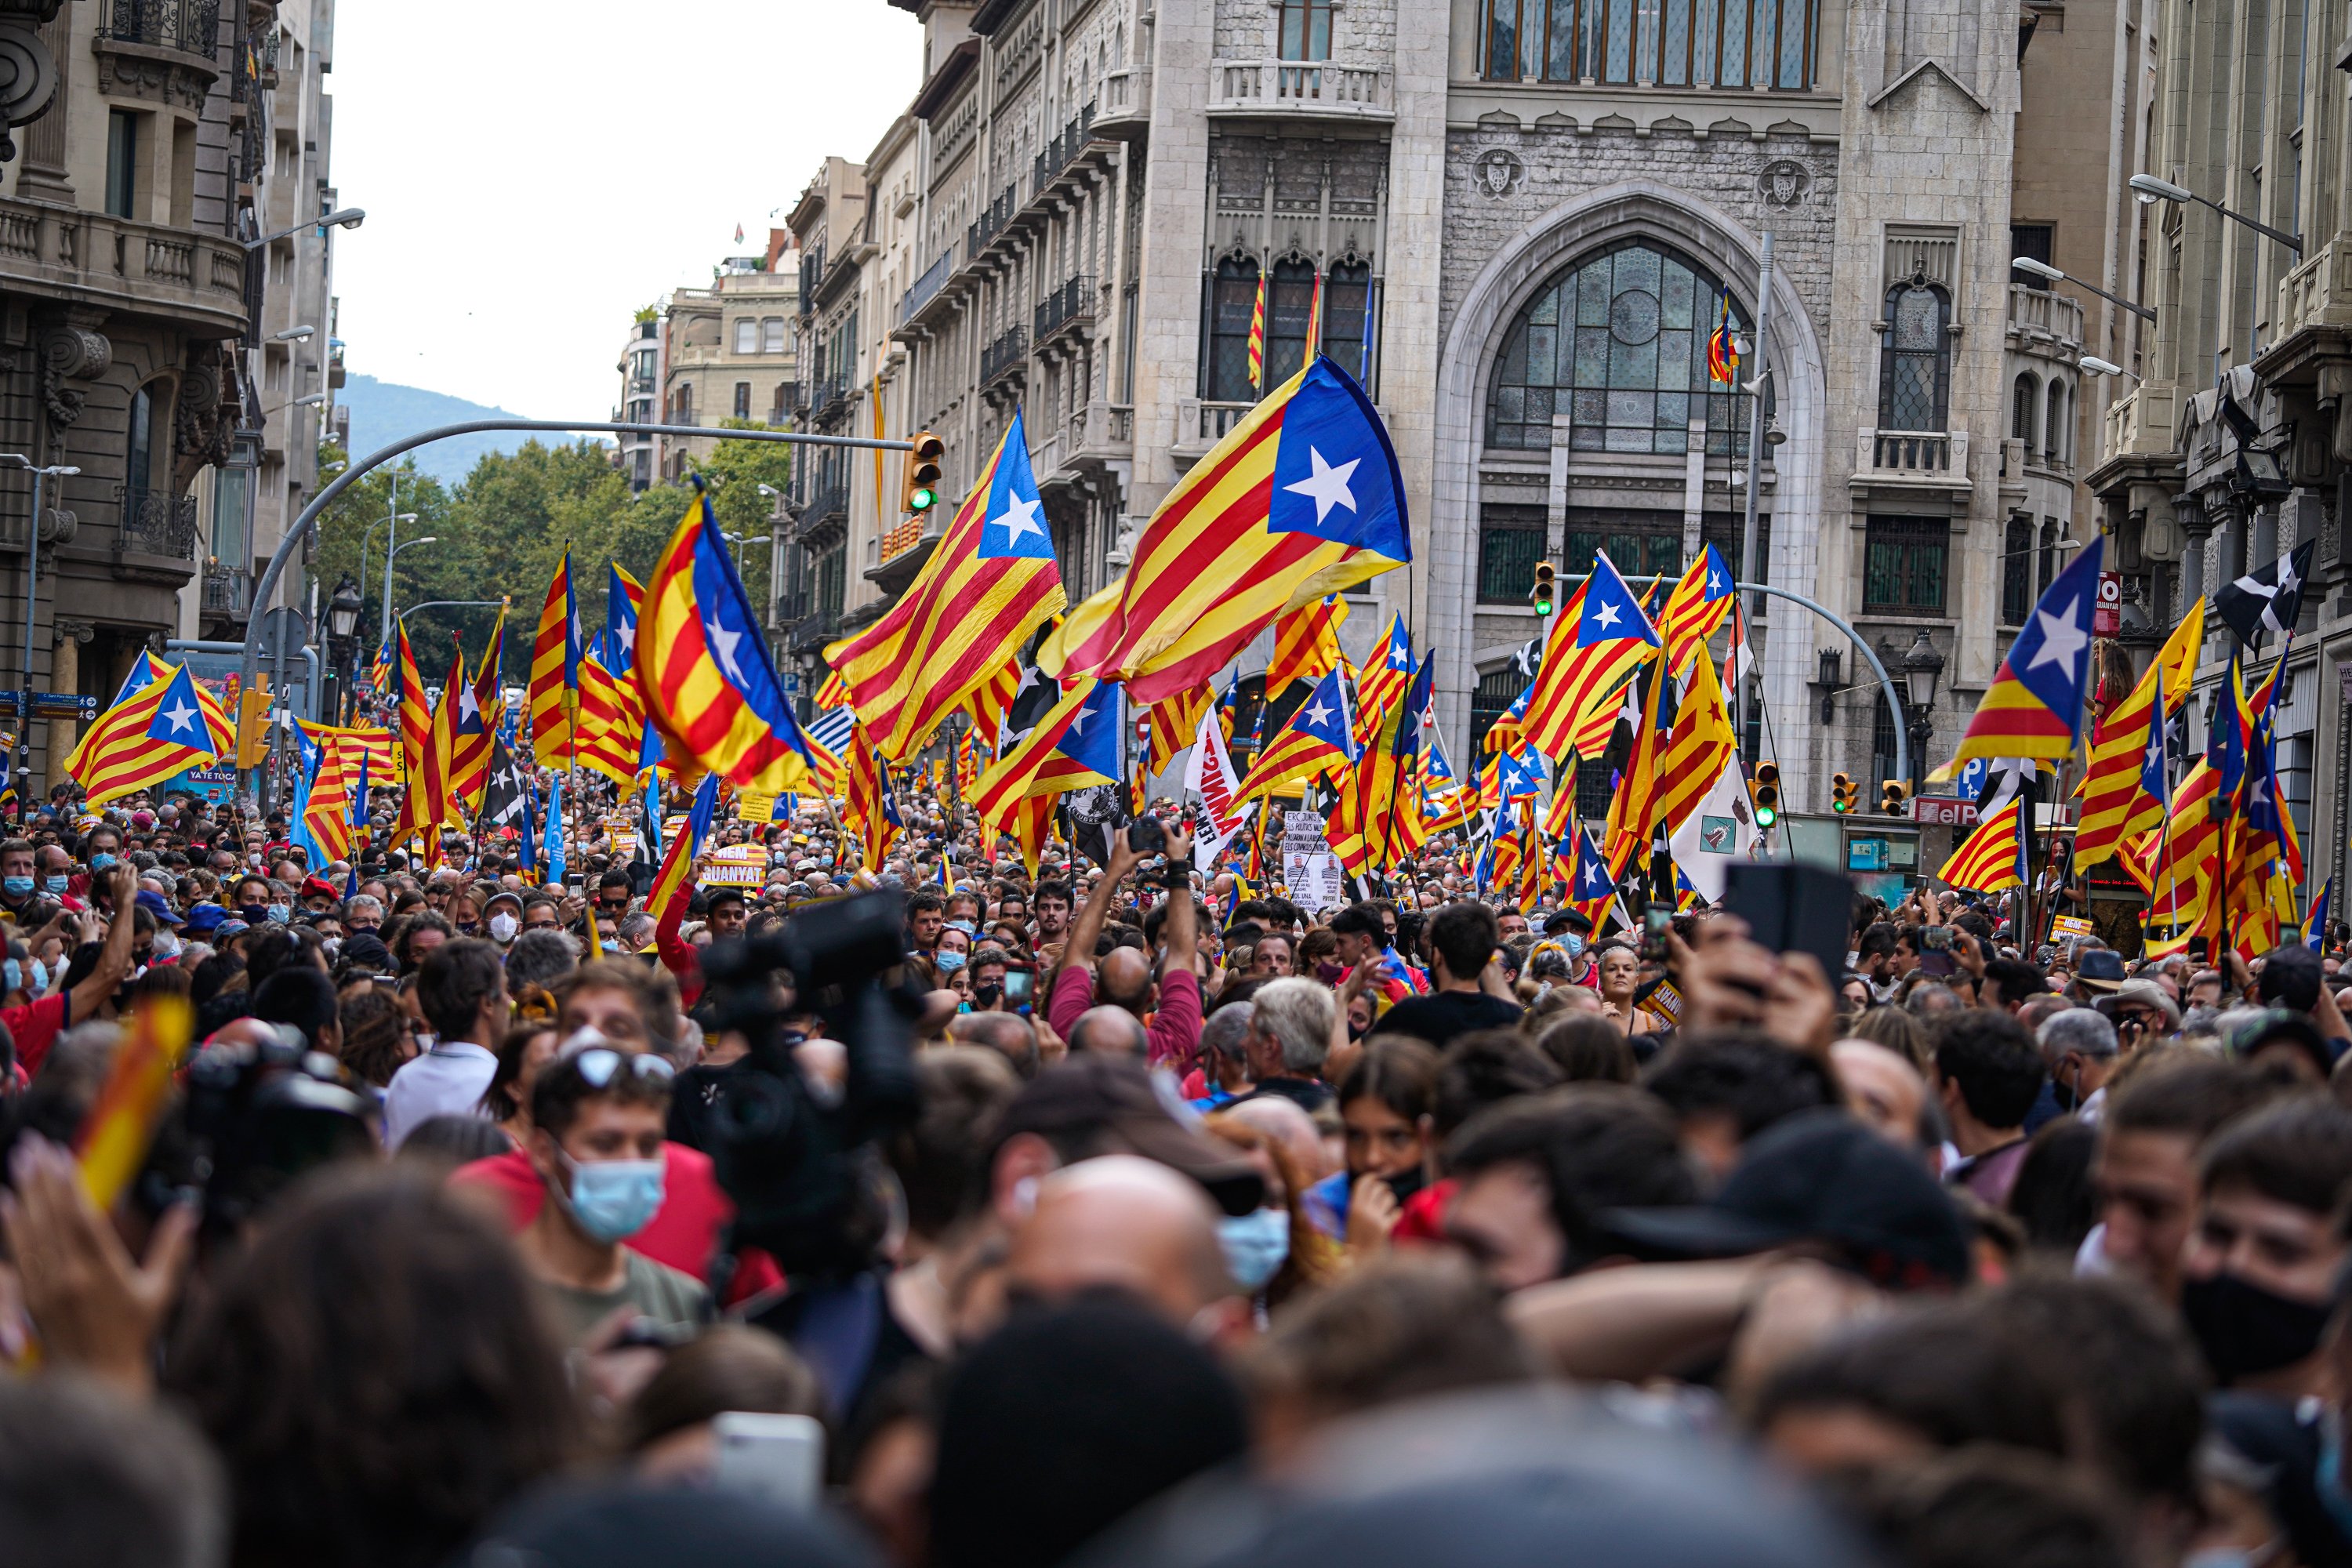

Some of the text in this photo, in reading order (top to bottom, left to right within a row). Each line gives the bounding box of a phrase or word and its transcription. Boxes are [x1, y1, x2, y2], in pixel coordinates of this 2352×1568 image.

[2096, 601, 2118, 610] GUANYAR
[784, 673, 797, 690] P
[190, 771, 201, 779] YA
[1962, 757, 1982, 784] P
[1069, 808, 1099, 823] CTUBRE
[717, 847, 748, 860] HEM
[702, 866, 762, 883] GUANYAT
[2063, 918, 2082, 930] HEM
